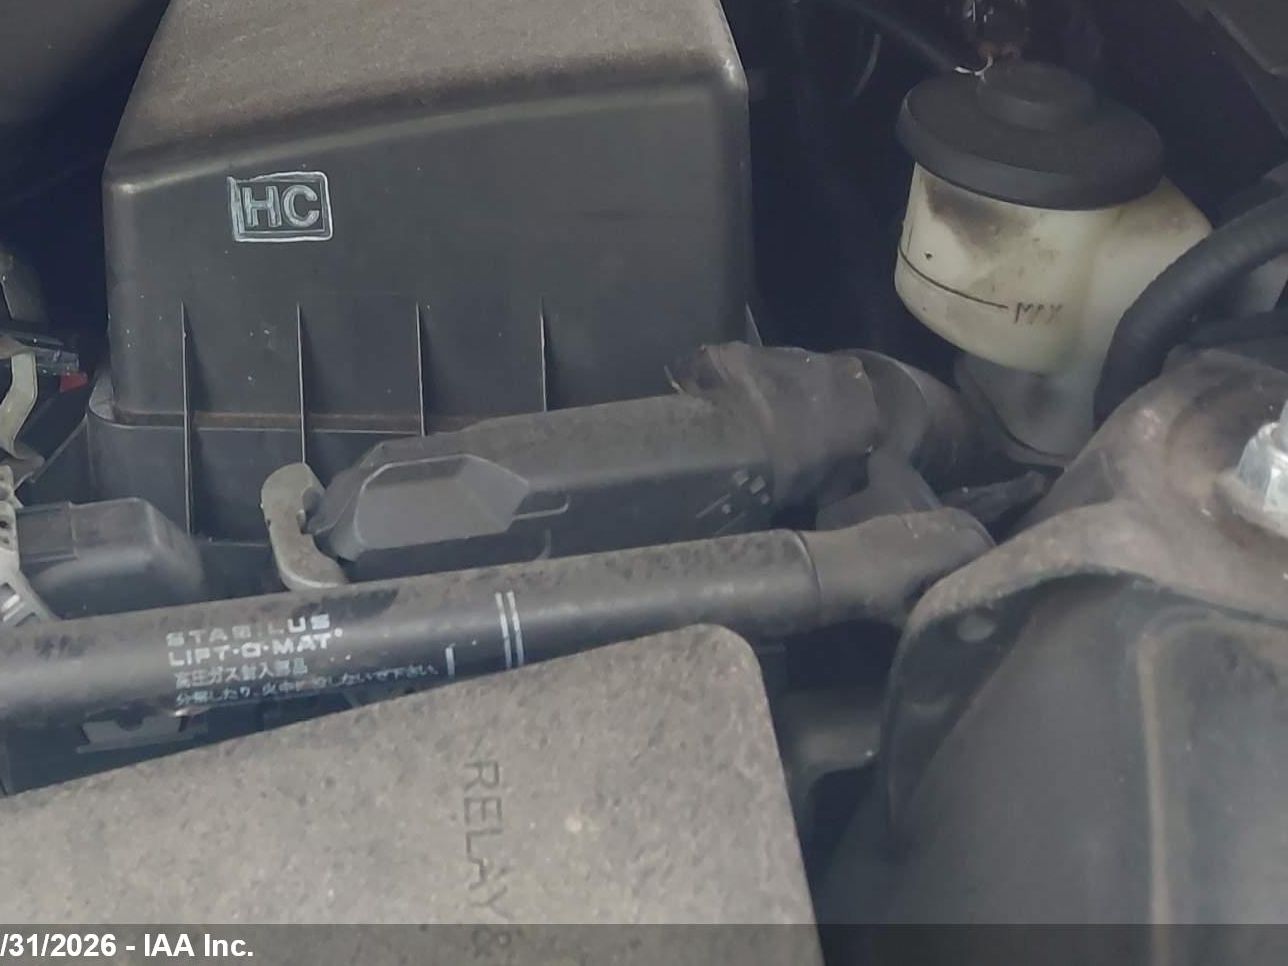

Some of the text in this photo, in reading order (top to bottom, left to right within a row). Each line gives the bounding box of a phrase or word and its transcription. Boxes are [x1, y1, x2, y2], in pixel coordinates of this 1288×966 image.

[242, 185, 320, 227] HC
[1015, 302, 1063, 325] MAX
[166, 614, 330, 646] STABLUS
[464, 760, 514, 922] RELAY
